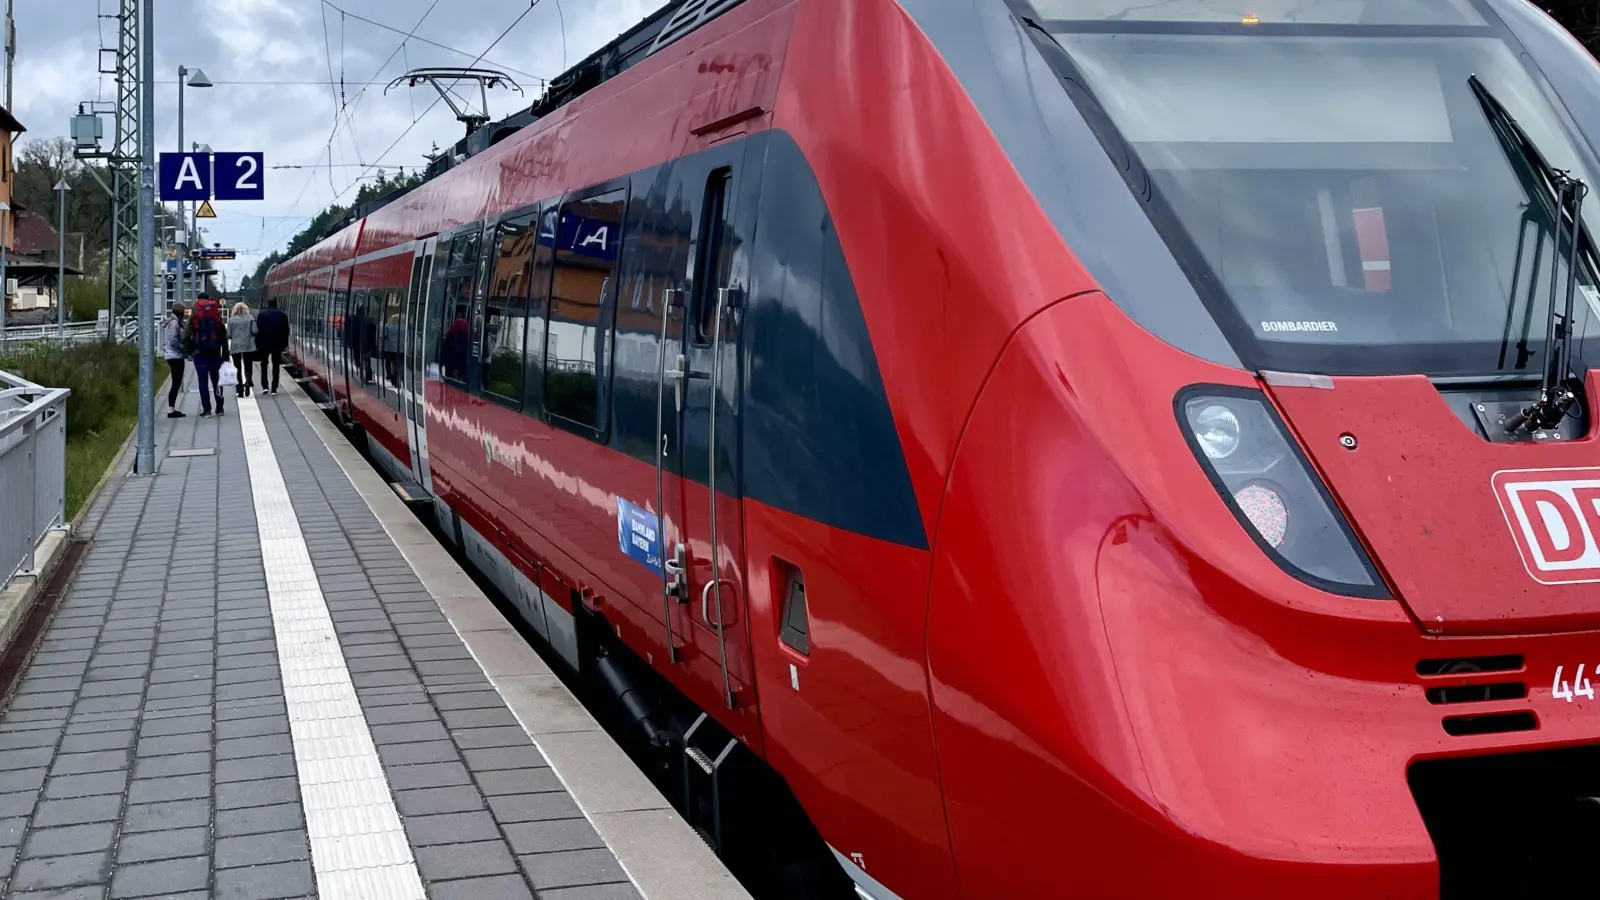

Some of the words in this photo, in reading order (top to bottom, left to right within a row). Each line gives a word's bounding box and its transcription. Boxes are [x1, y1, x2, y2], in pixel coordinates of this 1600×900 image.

[174, 156, 203, 190] A
[235, 155, 258, 189] 2
[1261, 321, 1338, 332] BOMBARDIER
[662, 434, 668, 457] 2
[1552, 663, 1600, 703] 44
